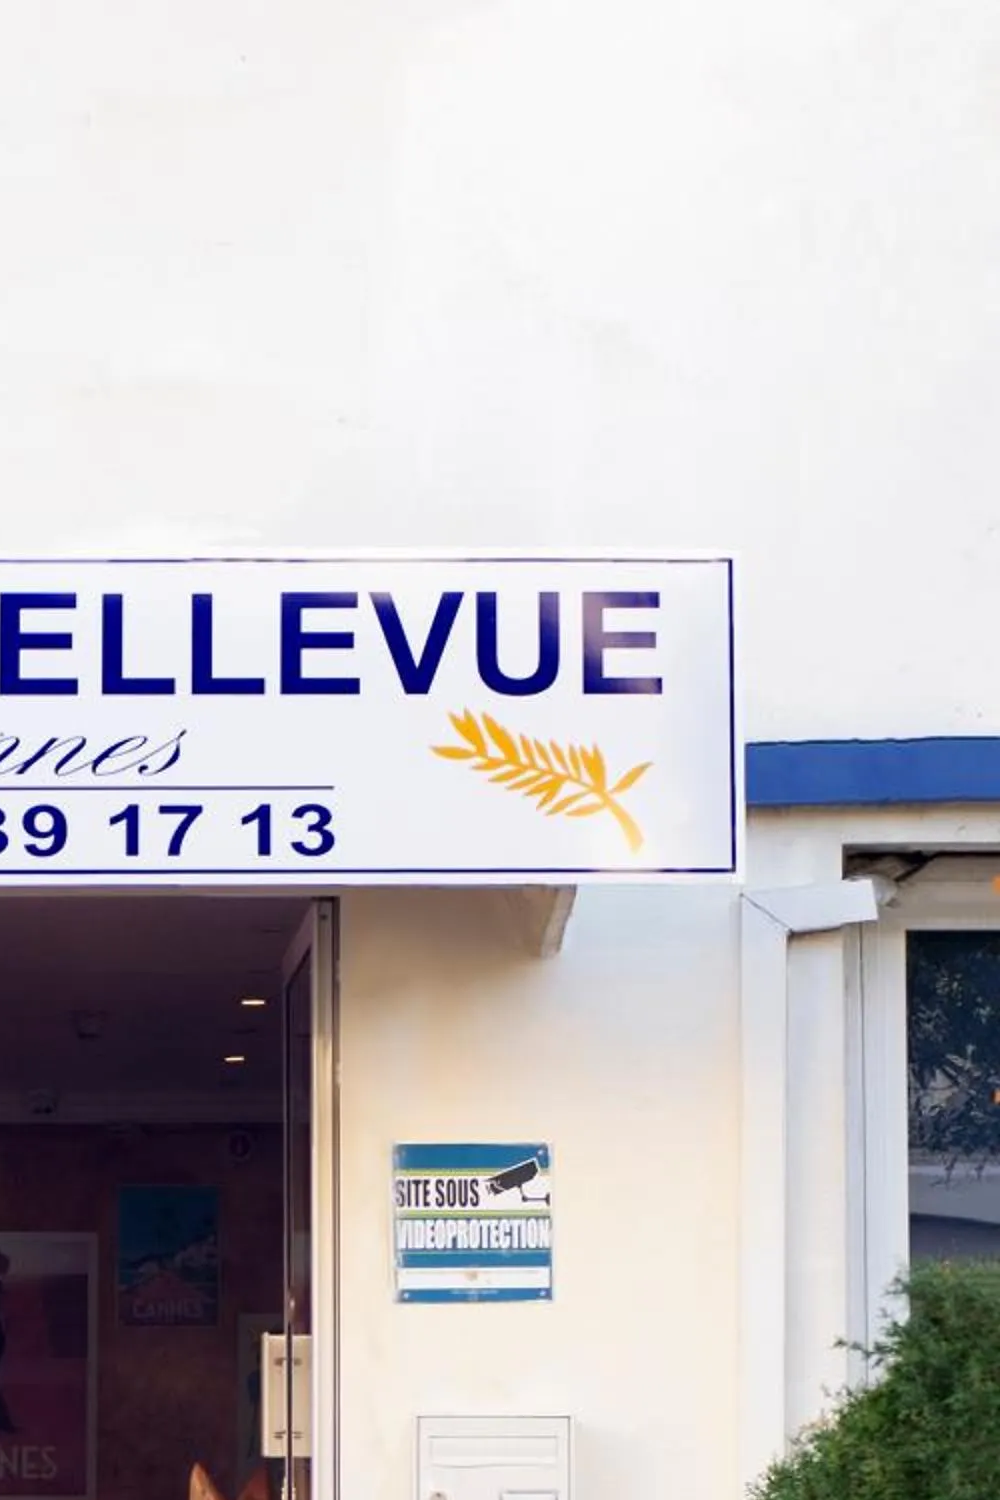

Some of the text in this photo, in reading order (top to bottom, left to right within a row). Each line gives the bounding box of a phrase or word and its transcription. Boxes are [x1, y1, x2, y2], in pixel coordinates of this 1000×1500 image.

[108, 803, 203, 857] 17
[240, 803, 337, 857] 13
[395, 1178, 480, 1208] SITE SOUS
[397, 1217, 550, 1250] VIDEOPROTECTION
